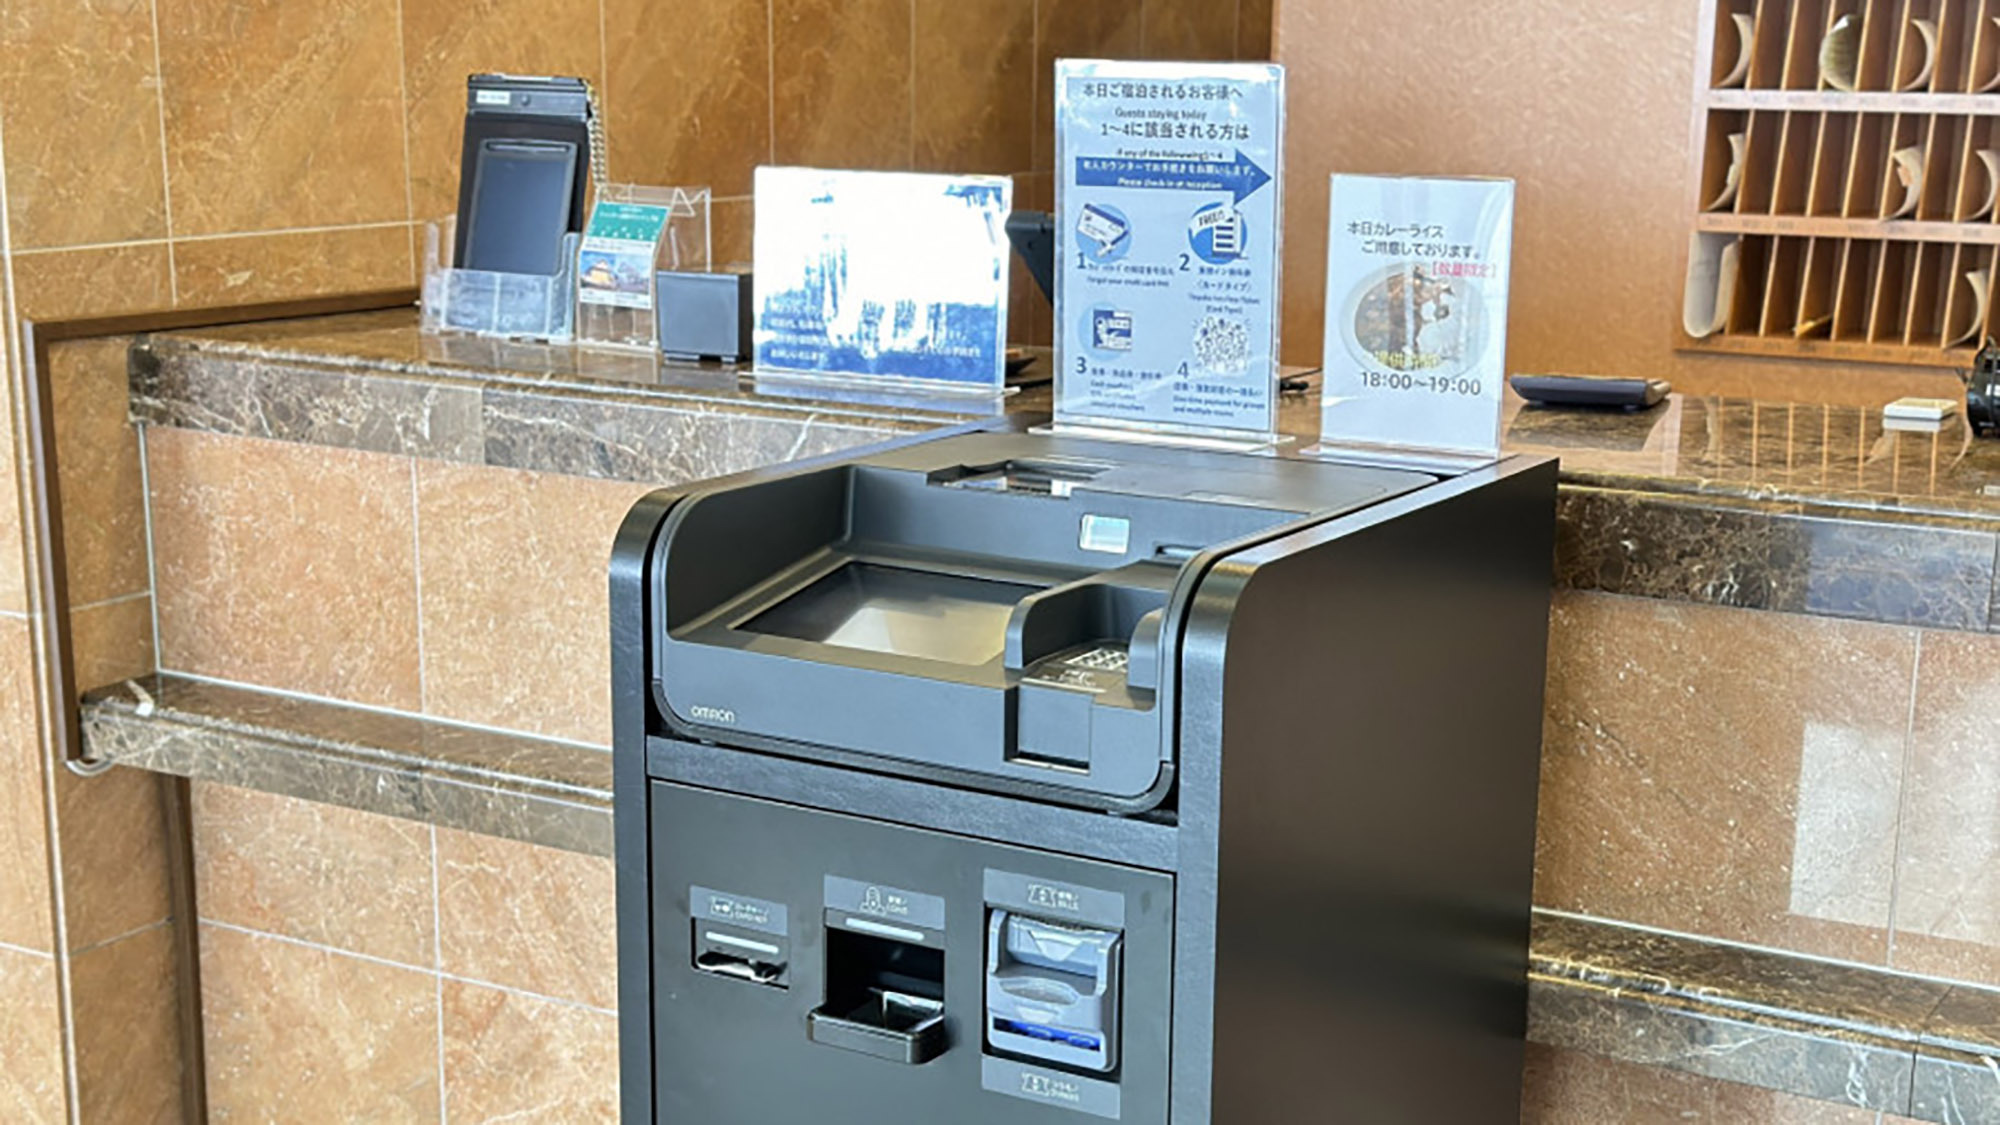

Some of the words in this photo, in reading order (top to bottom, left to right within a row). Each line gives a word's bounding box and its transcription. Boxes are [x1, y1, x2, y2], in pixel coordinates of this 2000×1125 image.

[1083, 82, 1243, 101] 本日ご宿泊されるお客様へ
[1347, 221, 1444, 239] 本日カレーライス
[1361, 239, 1480, 260] ご用意しております。
[1077, 252, 1086, 269] 1
[1179, 253, 1190, 272] 2
[1076, 356, 1087, 374] 3
[1177, 361, 1189, 378] 4
